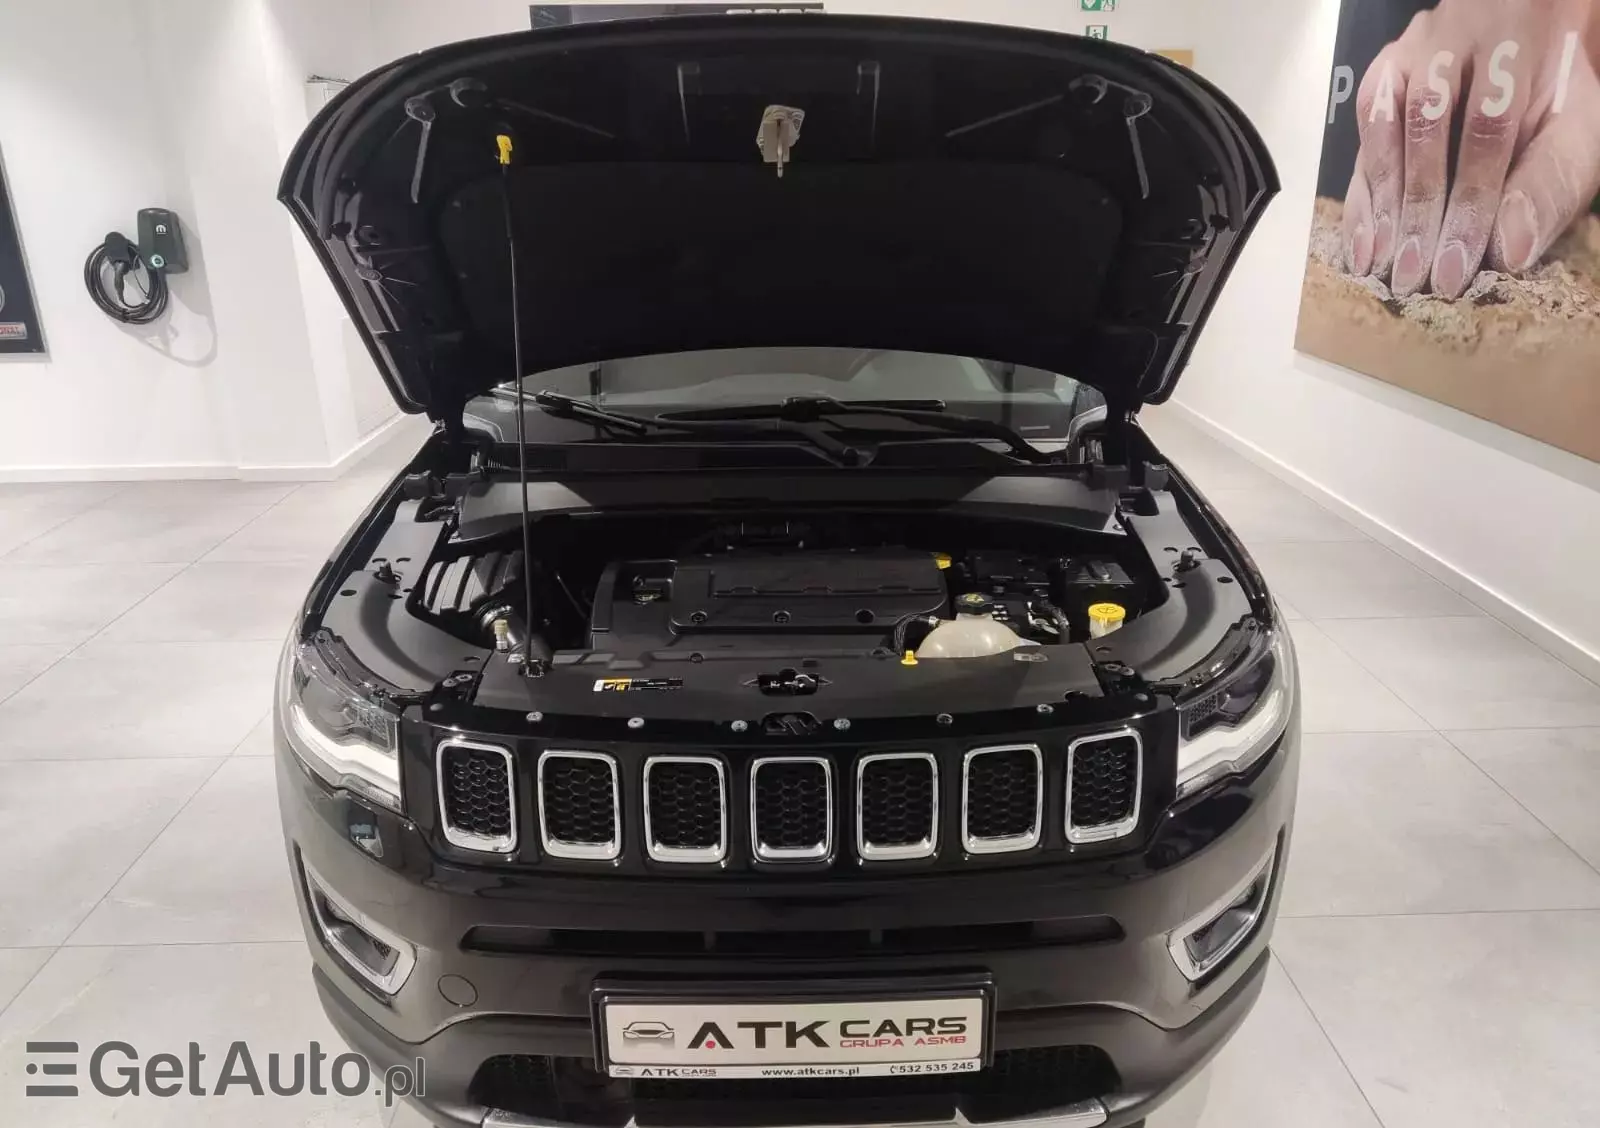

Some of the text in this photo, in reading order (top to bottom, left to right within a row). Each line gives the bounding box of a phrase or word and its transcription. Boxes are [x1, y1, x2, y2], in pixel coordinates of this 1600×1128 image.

[1327, 31, 1579, 124] PASSI
[687, 1016, 968, 1049] ATK CARS
[840, 1036, 966, 1048] GRUPA ASMB
[641, 1068, 679, 1077] ATK
[762, 1066, 860, 1078] www.atkcars.pl
[899, 1061, 974, 1073] 532 535 245
